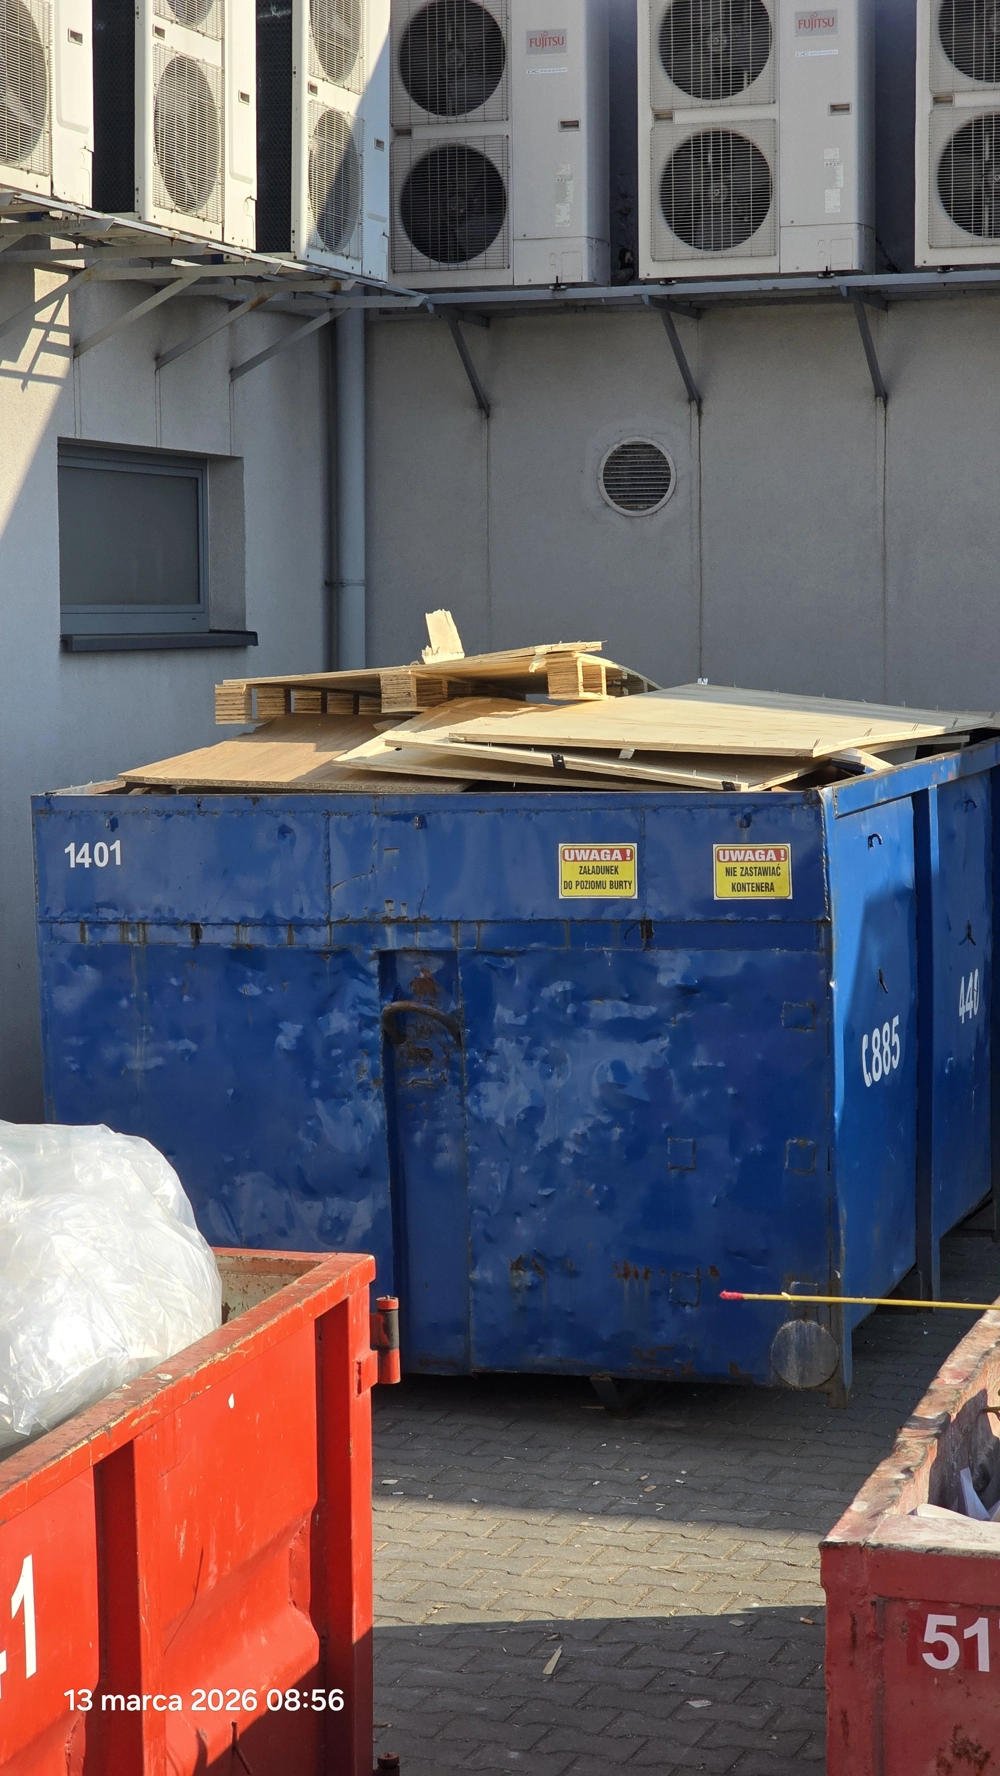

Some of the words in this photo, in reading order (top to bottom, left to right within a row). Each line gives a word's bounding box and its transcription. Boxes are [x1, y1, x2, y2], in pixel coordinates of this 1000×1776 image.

[797, 12, 835, 31] FUJITSU
[529, 31, 565, 49] FUJITSU
[64, 839, 122, 869] 1401
[564, 849, 622, 861] UWAGA
[719, 850, 777, 862] UWAGA
[578, 865, 619, 875] ZAŁADUNEK
[725, 867, 738, 877] NIE
[739, 863, 781, 877] ZASTAWIAĆ
[563, 880, 573, 890] DO
[575, 880, 607, 890] POZIOMU
[609, 880, 633, 890] BURTY
[731, 882, 775, 893] KONTENERA
[958, 968, 980, 1025] 440
[862, 1014, 901, 1088] C885
[921, 1613, 1000, 1673] 51
